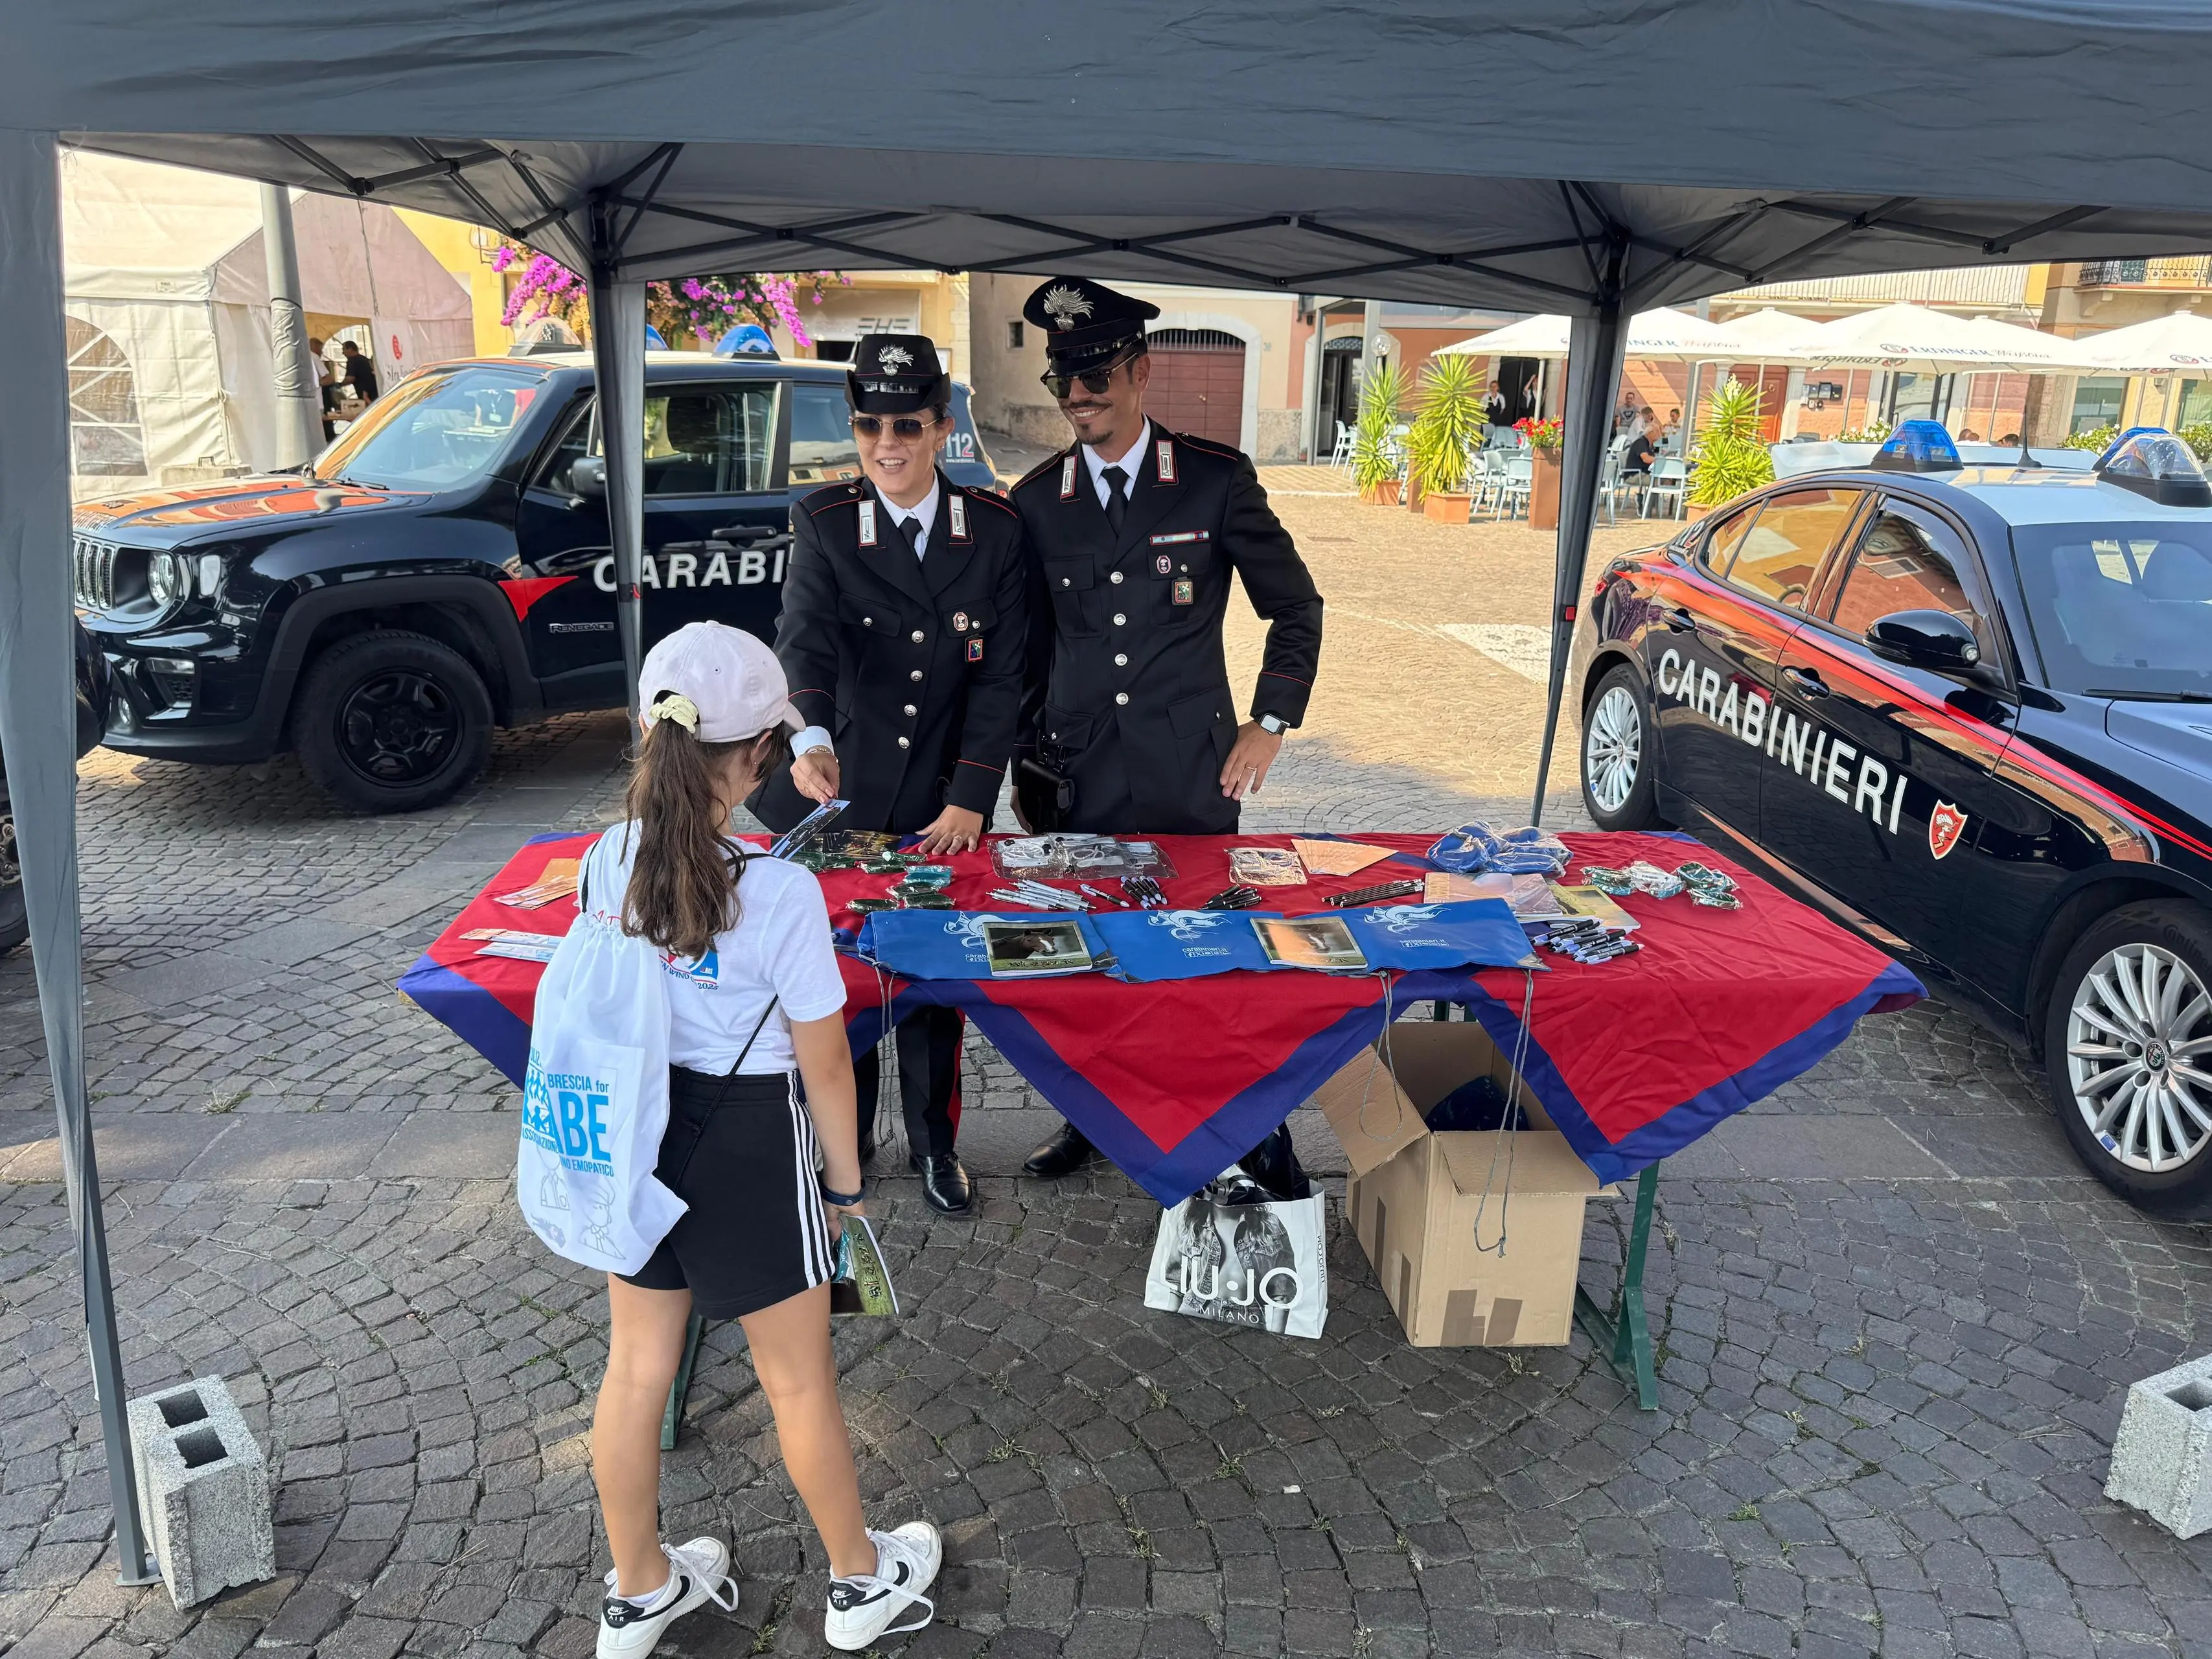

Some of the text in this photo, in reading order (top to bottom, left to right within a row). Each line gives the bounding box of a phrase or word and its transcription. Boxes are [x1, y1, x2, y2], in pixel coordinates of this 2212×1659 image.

[1909, 347, 1995, 357] ERDINGER
[946, 432, 975, 458] 112
[593, 550, 785, 593] CARABI
[549, 622, 614, 633] RENEGADE
[1658, 647, 1908, 835] CARABINIERI
[669, 968, 689, 979] WIND
[697, 982, 719, 990] 2025
[547, 1073, 609, 1093] BRESCIA for
[572, 1159, 614, 1177] EMOPATICO
[1199, 1305, 1259, 1324] MILANO
